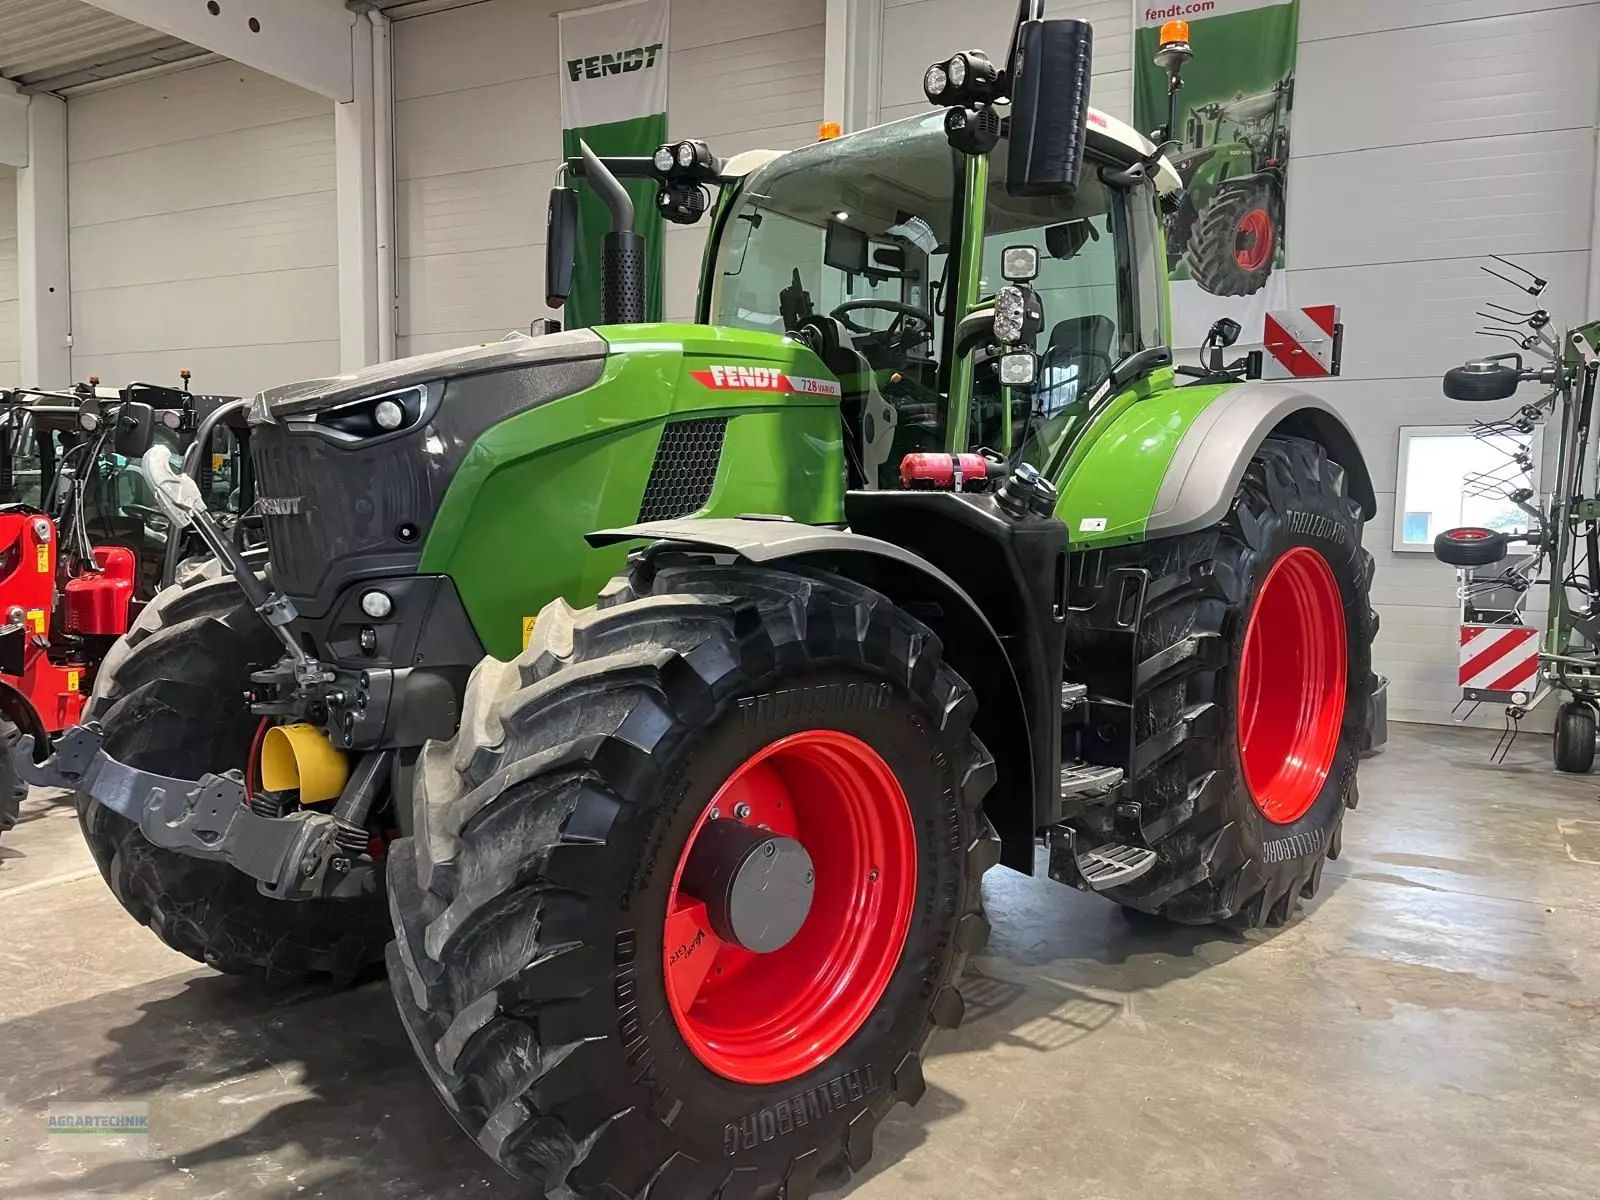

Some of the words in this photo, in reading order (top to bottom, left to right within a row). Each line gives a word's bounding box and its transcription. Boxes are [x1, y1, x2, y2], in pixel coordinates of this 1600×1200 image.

[1145, 1, 1215, 20] fendt.com
[567, 44, 663, 82] FENDT
[709, 365, 781, 388] FENDT
[801, 379, 817, 392] 728
[818, 385, 835, 394] VARIO
[1286, 509, 1346, 545] TRELLEBORG
[720, 1064, 878, 1156] TRELLEBORG
